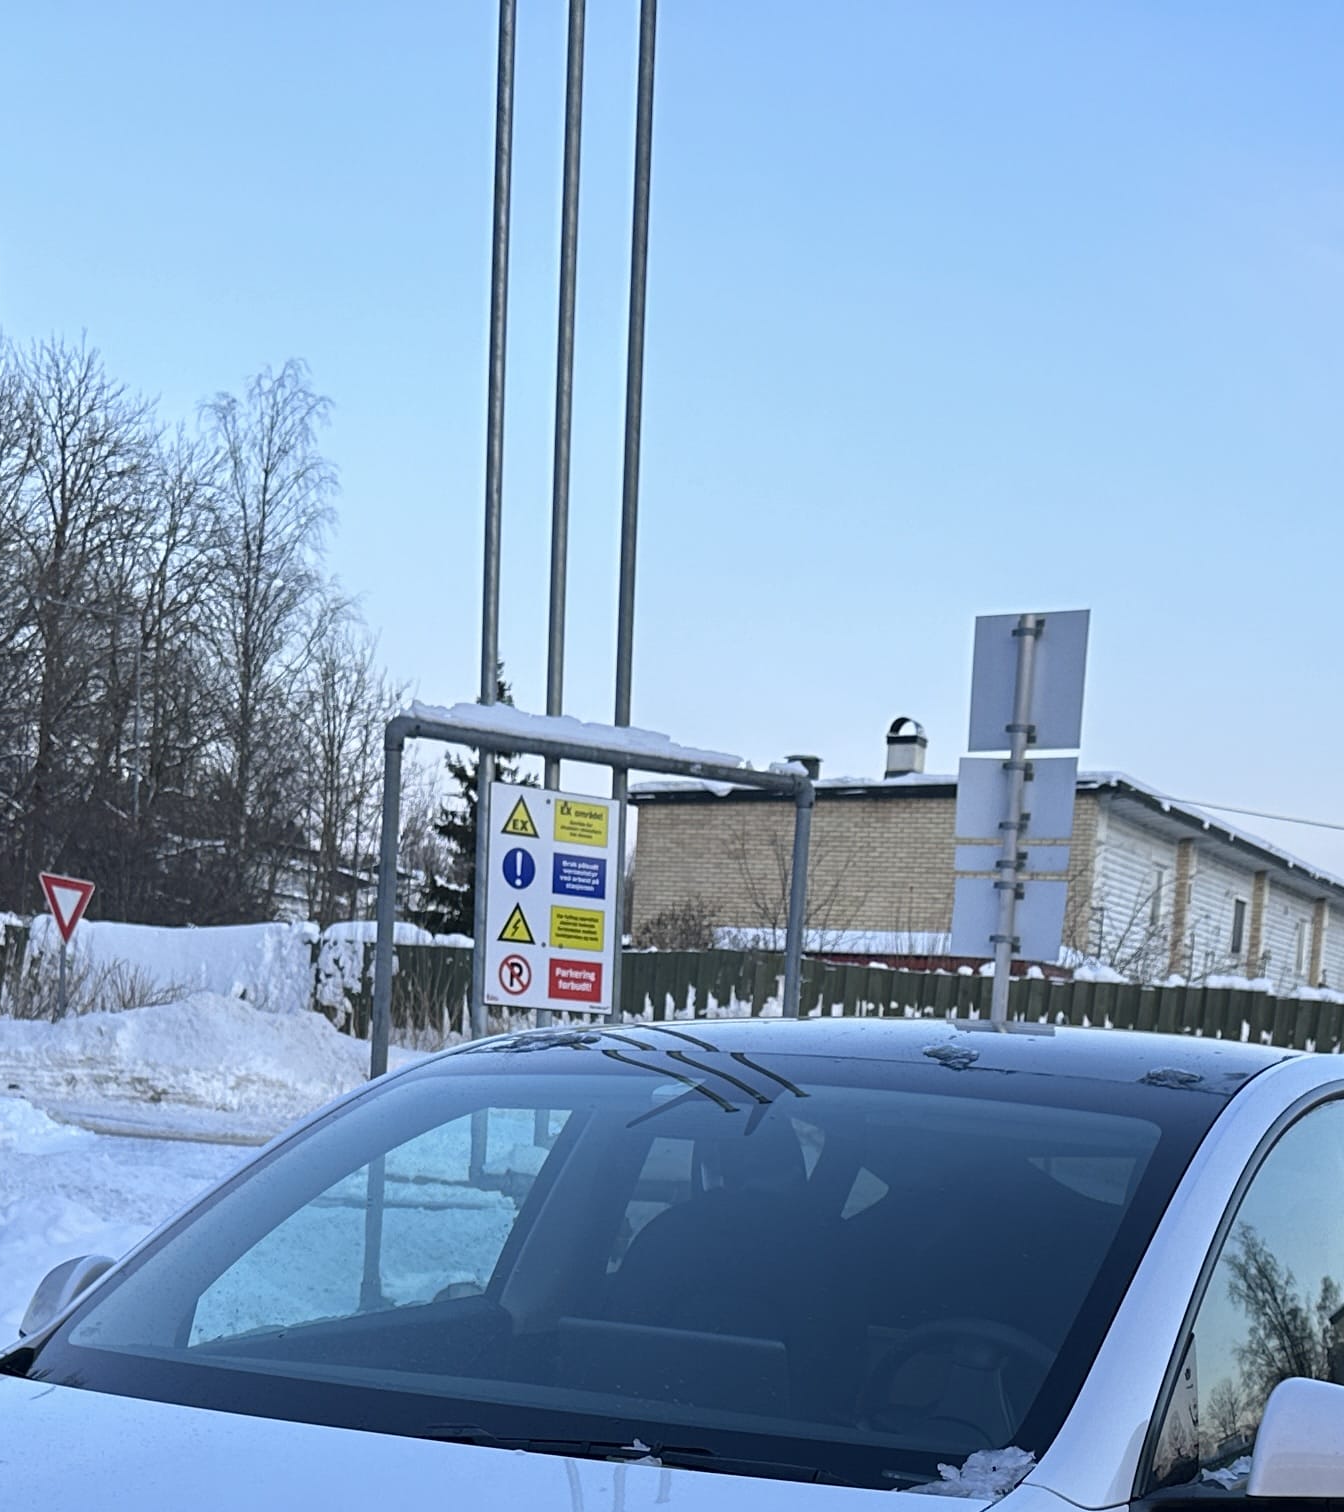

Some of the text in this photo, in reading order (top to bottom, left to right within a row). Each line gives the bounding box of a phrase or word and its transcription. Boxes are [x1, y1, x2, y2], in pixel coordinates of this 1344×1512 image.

[513, 818, 529, 832] EX
[555, 967, 596, 982] Parkering
[558, 979, 593, 993] forbudt!
